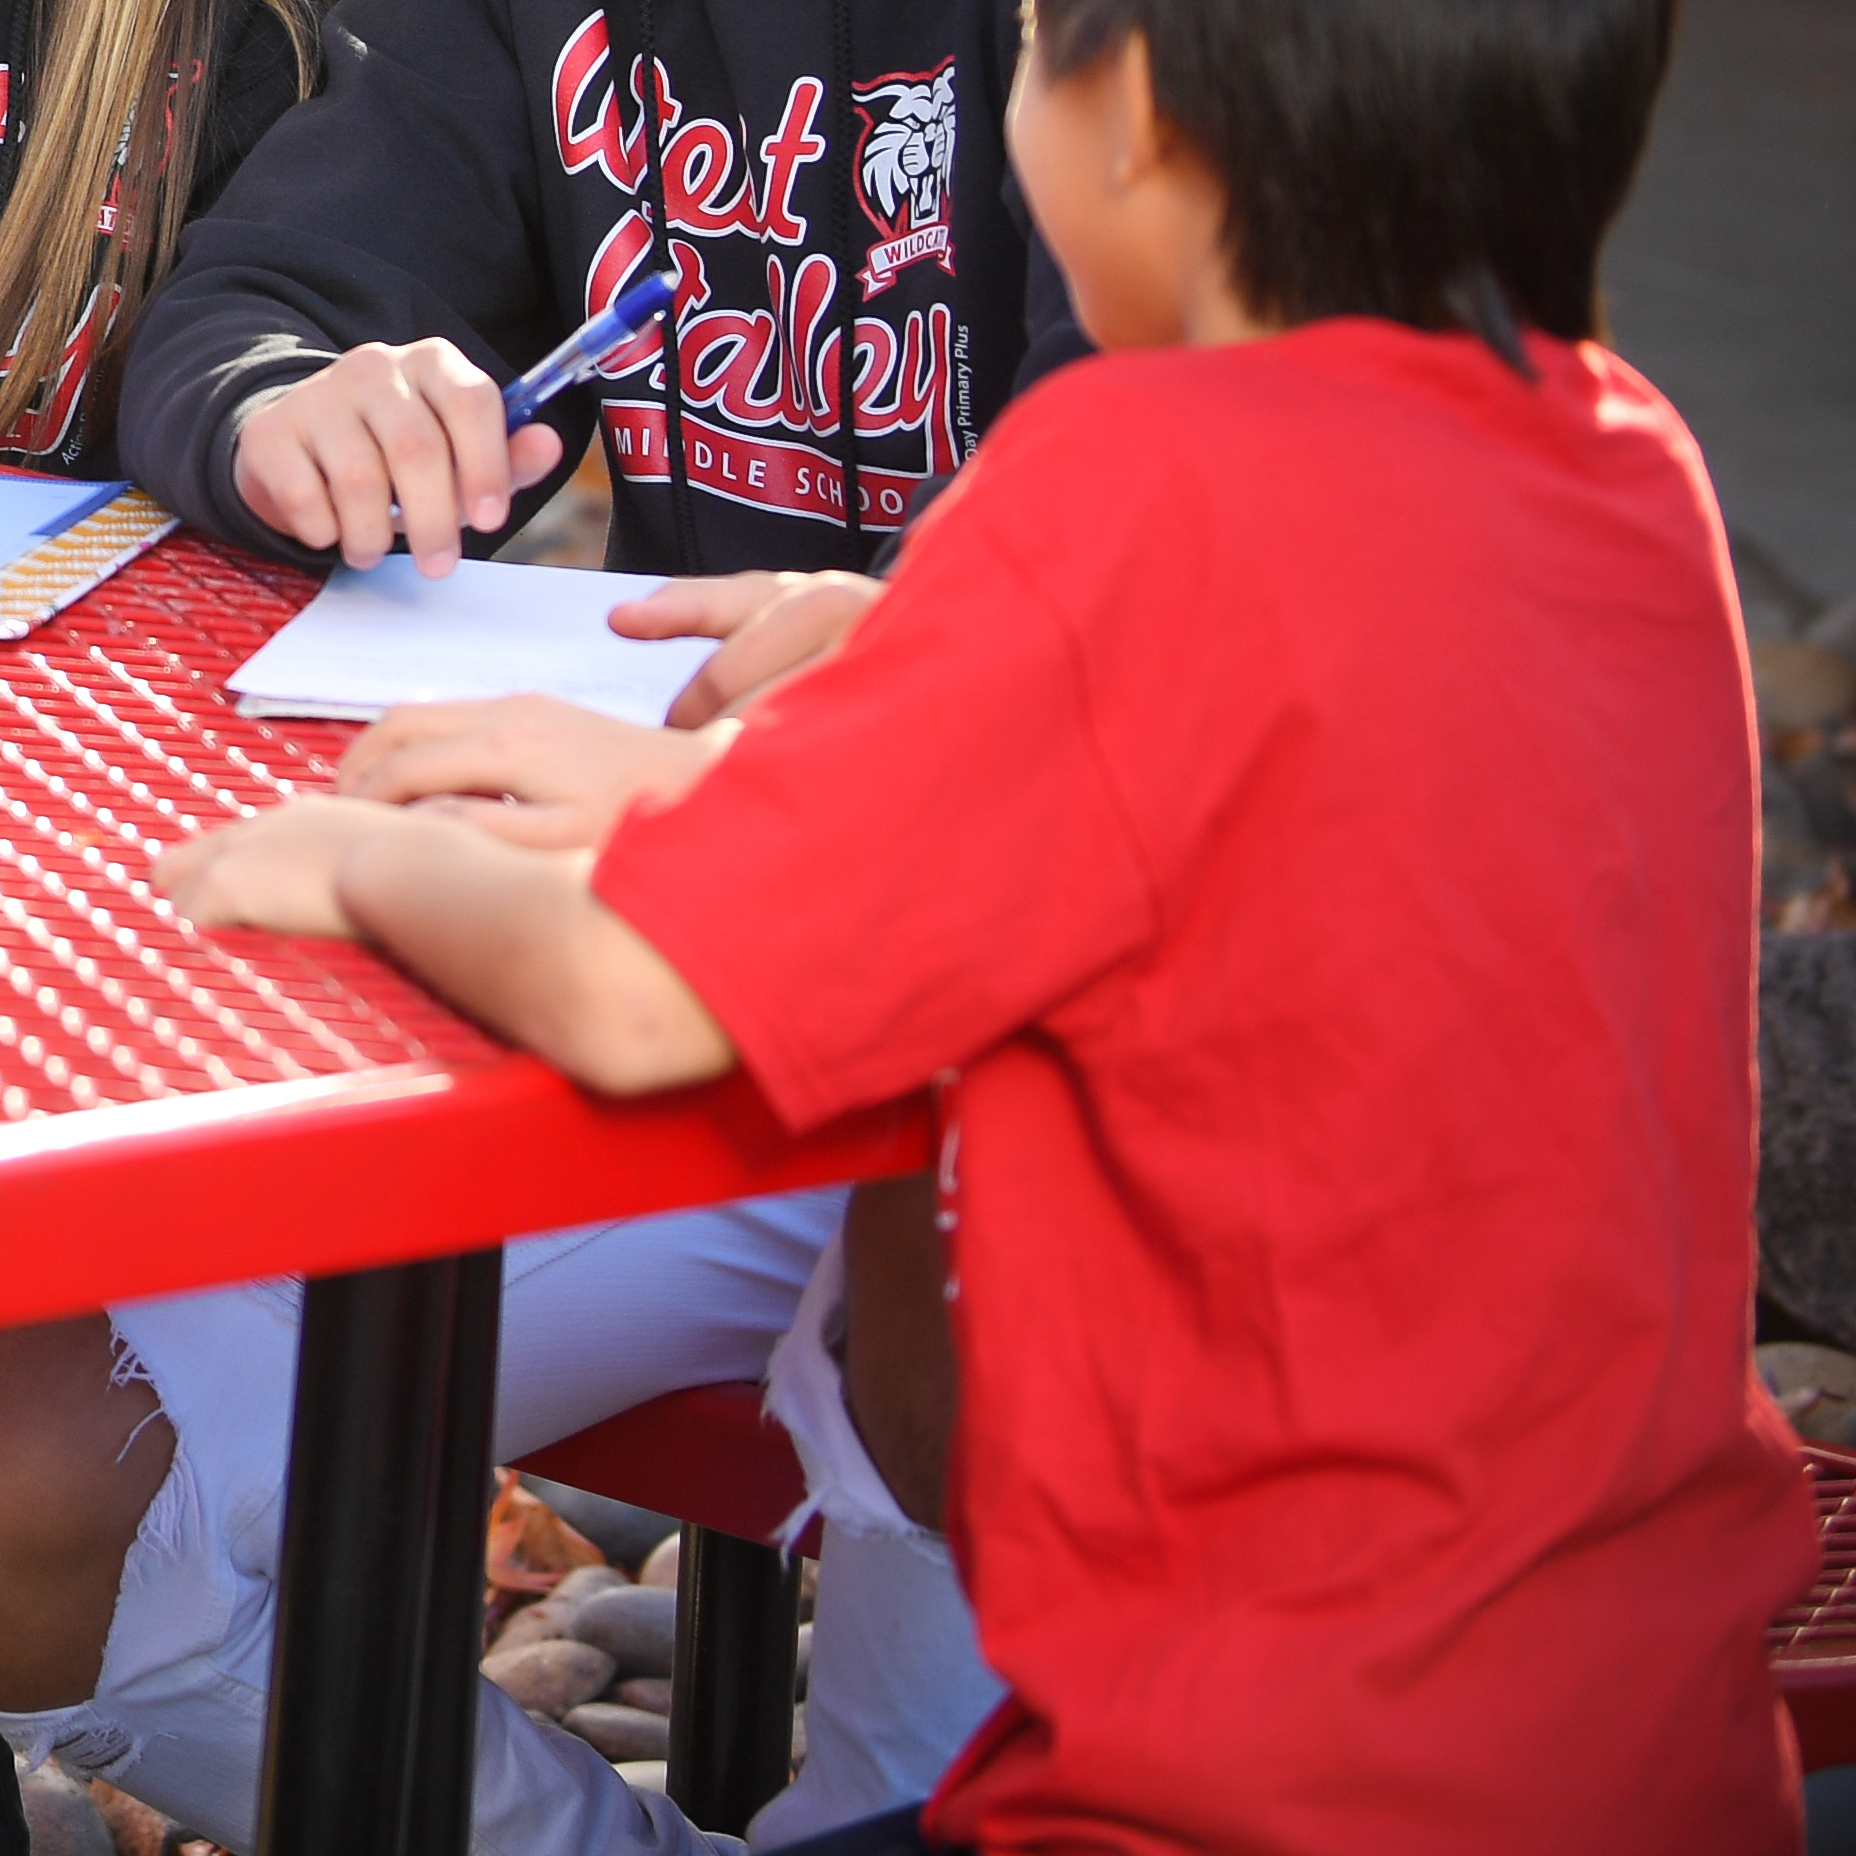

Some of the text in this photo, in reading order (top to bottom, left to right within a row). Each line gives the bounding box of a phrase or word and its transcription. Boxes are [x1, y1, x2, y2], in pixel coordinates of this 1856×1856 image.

[552, 8, 826, 246] Wet
[954, 324, 970, 360] Plus
[956, 362, 974, 427] Primary
[794, 467, 905, 517] SCHOO
